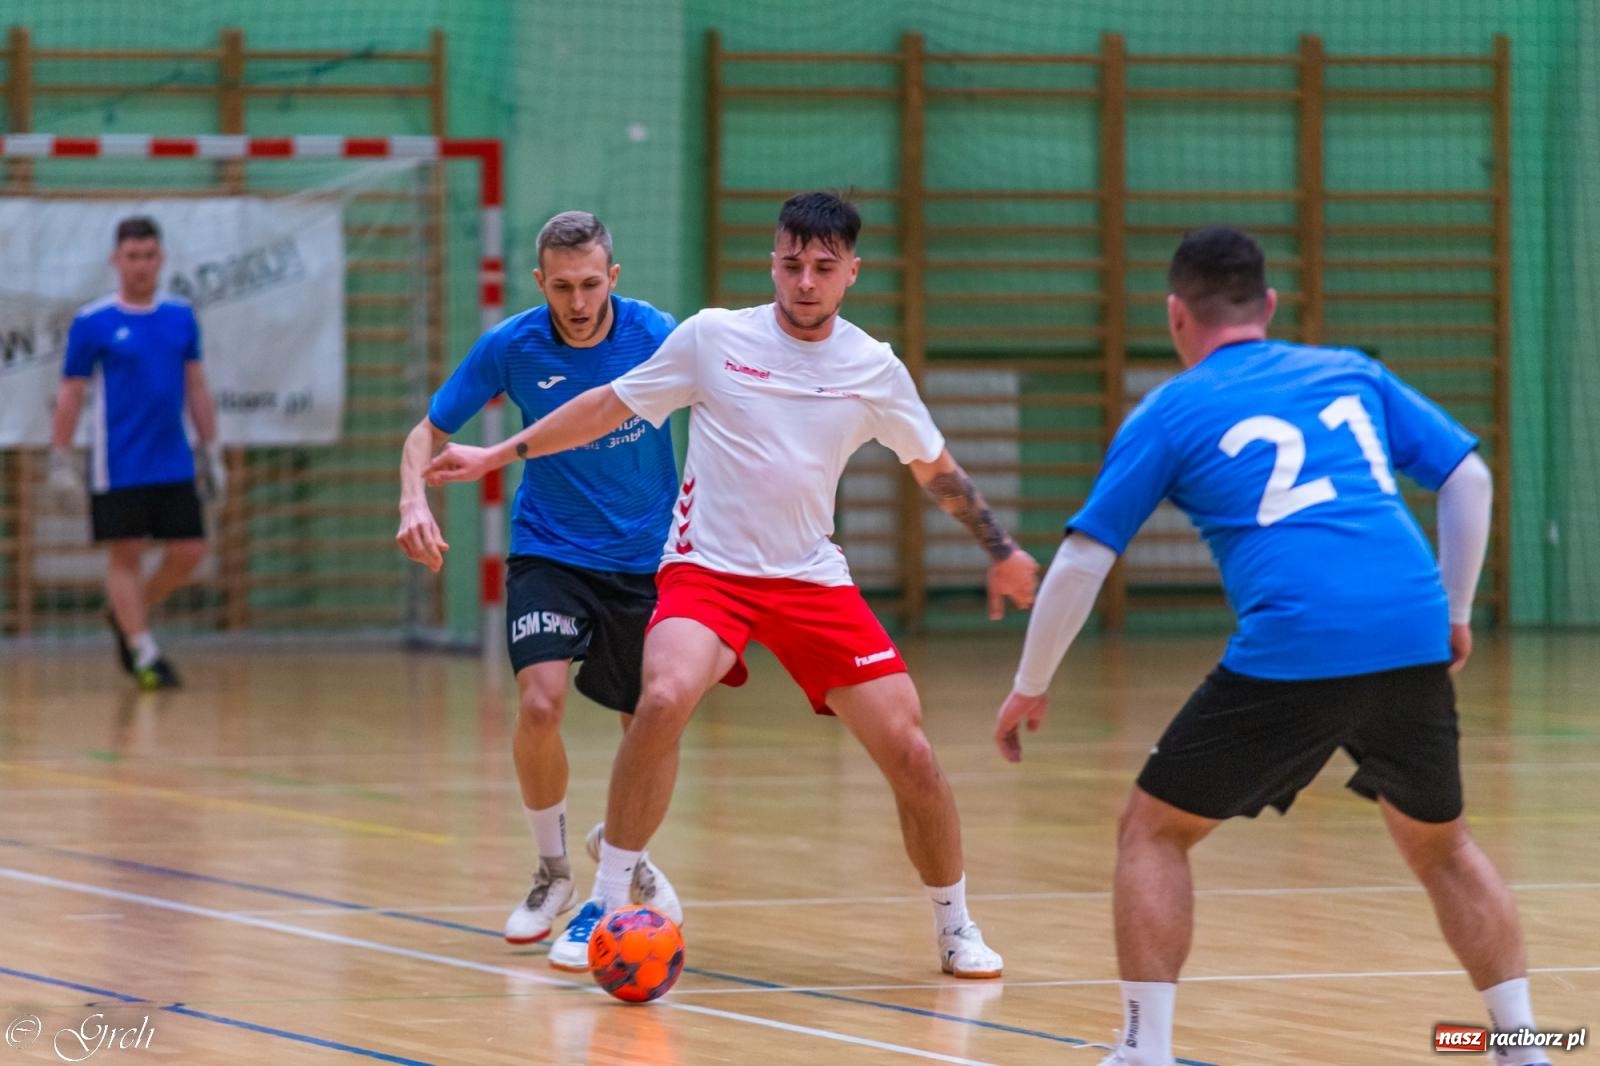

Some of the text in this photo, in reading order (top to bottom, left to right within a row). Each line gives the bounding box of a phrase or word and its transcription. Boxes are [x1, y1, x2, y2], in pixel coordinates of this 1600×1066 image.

[725, 360, 771, 380] hummel
[1218, 394, 1397, 527] 21
[512, 611, 540, 644] LSM
[854, 647, 896, 668] hummel
